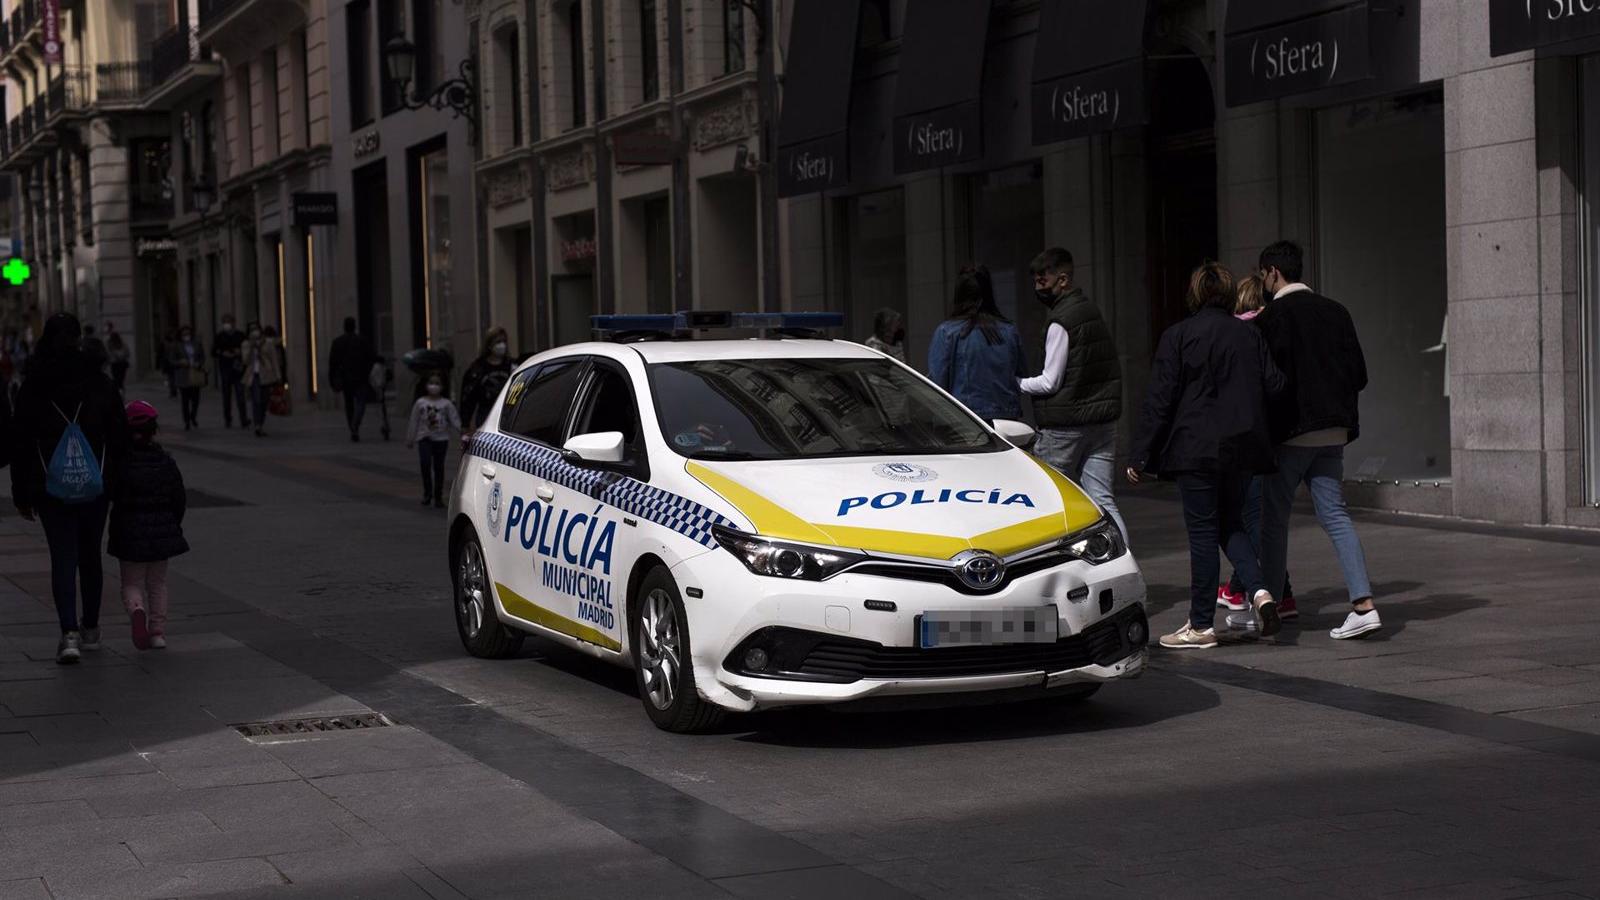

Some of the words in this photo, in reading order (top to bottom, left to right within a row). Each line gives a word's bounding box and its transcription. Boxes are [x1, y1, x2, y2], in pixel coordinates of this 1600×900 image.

[836, 488, 1036, 517] POLICÍA
[504, 495, 617, 576] POLICÍA
[542, 561, 613, 610] MUNICIPAL
[577, 601, 615, 631] MADRID
